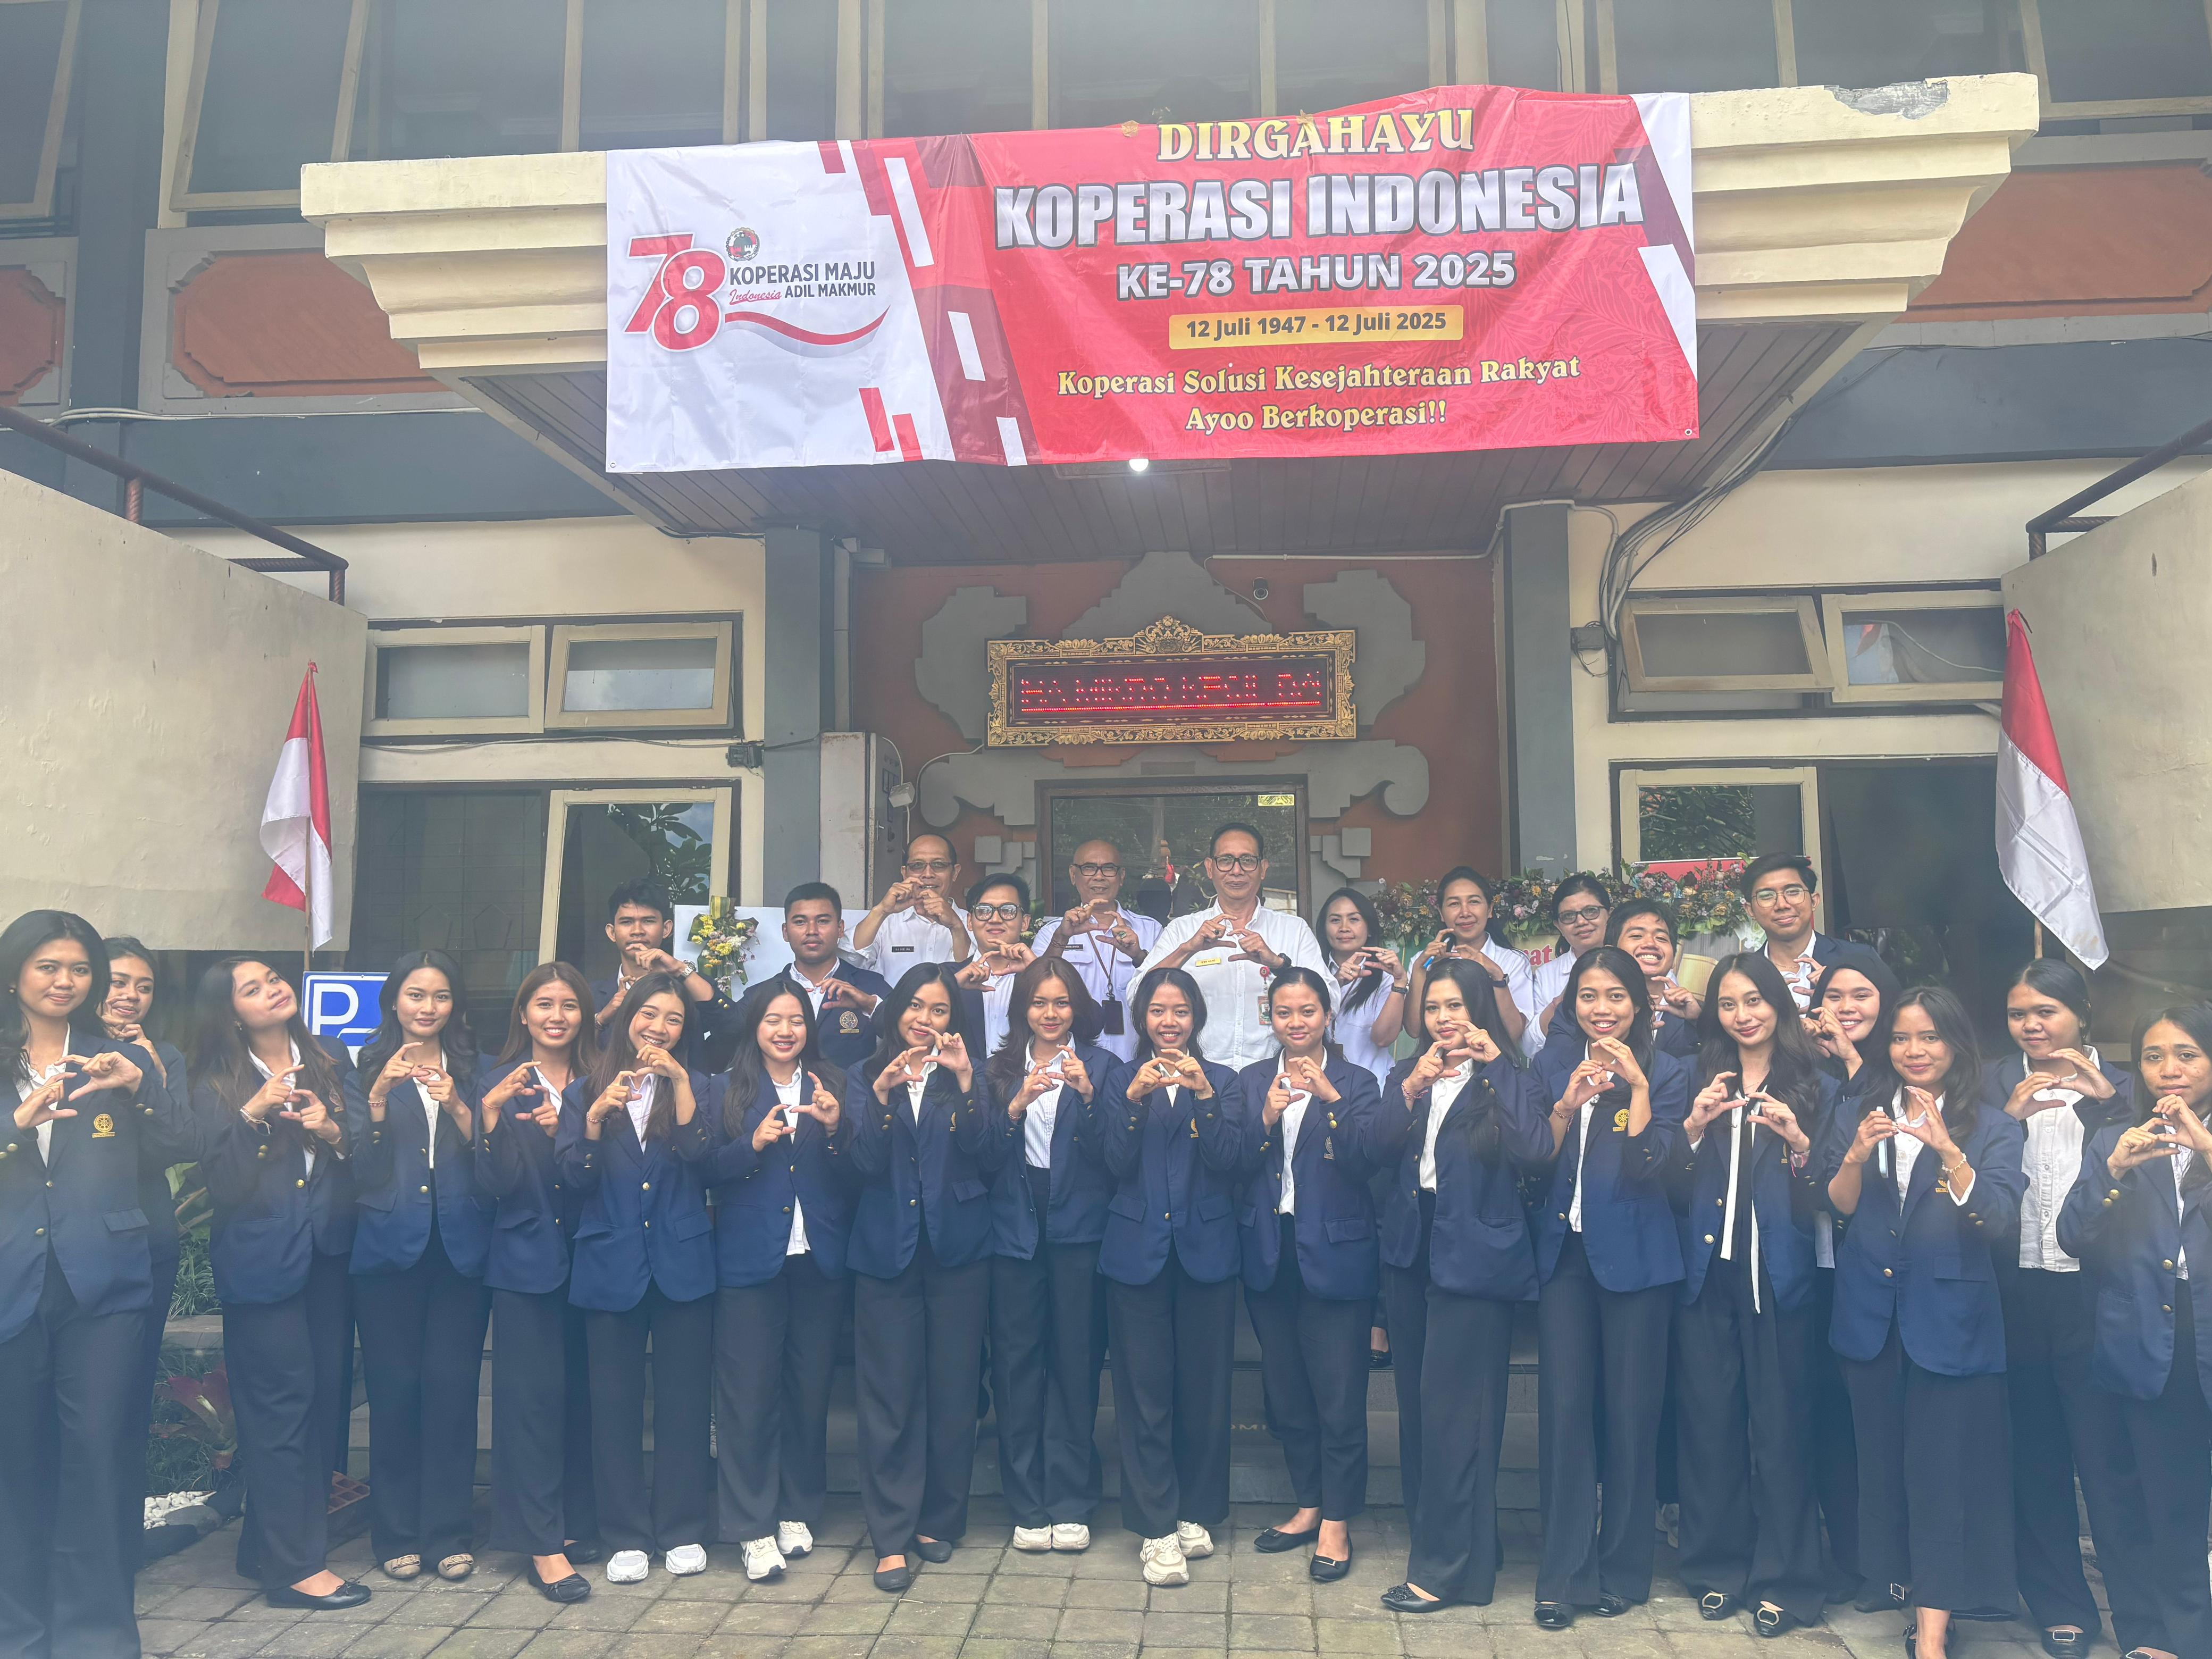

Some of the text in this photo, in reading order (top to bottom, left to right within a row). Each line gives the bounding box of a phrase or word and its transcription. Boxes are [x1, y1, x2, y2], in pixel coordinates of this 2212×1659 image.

[1157, 108, 1474, 161] DIRGAHAYU
[993, 161, 1645, 250] KOPERASI INDONESIA
[623, 232, 727, 351] 78
[729, 282, 876, 305] Indonesia ADIL MAKMUR
[730, 261, 875, 286] KOPERASI MAJU
[1117, 250, 1516, 301] KE-78 TAHUN 2025
[1186, 320, 1210, 338] 12
[1213, 317, 1251, 341] Juli
[1257, 315, 1306, 335] 1947
[1325, 314, 1349, 332] 12
[1353, 312, 1390, 336] Juli
[1396, 312, 1446, 330] 2025
[1058, 355, 1581, 399] Koperasi Solusi Kesejahteraan Rakyat
[1185, 399, 1448, 435] Ayoo Berkoperasi!!
[312, 983, 359, 1036] P
